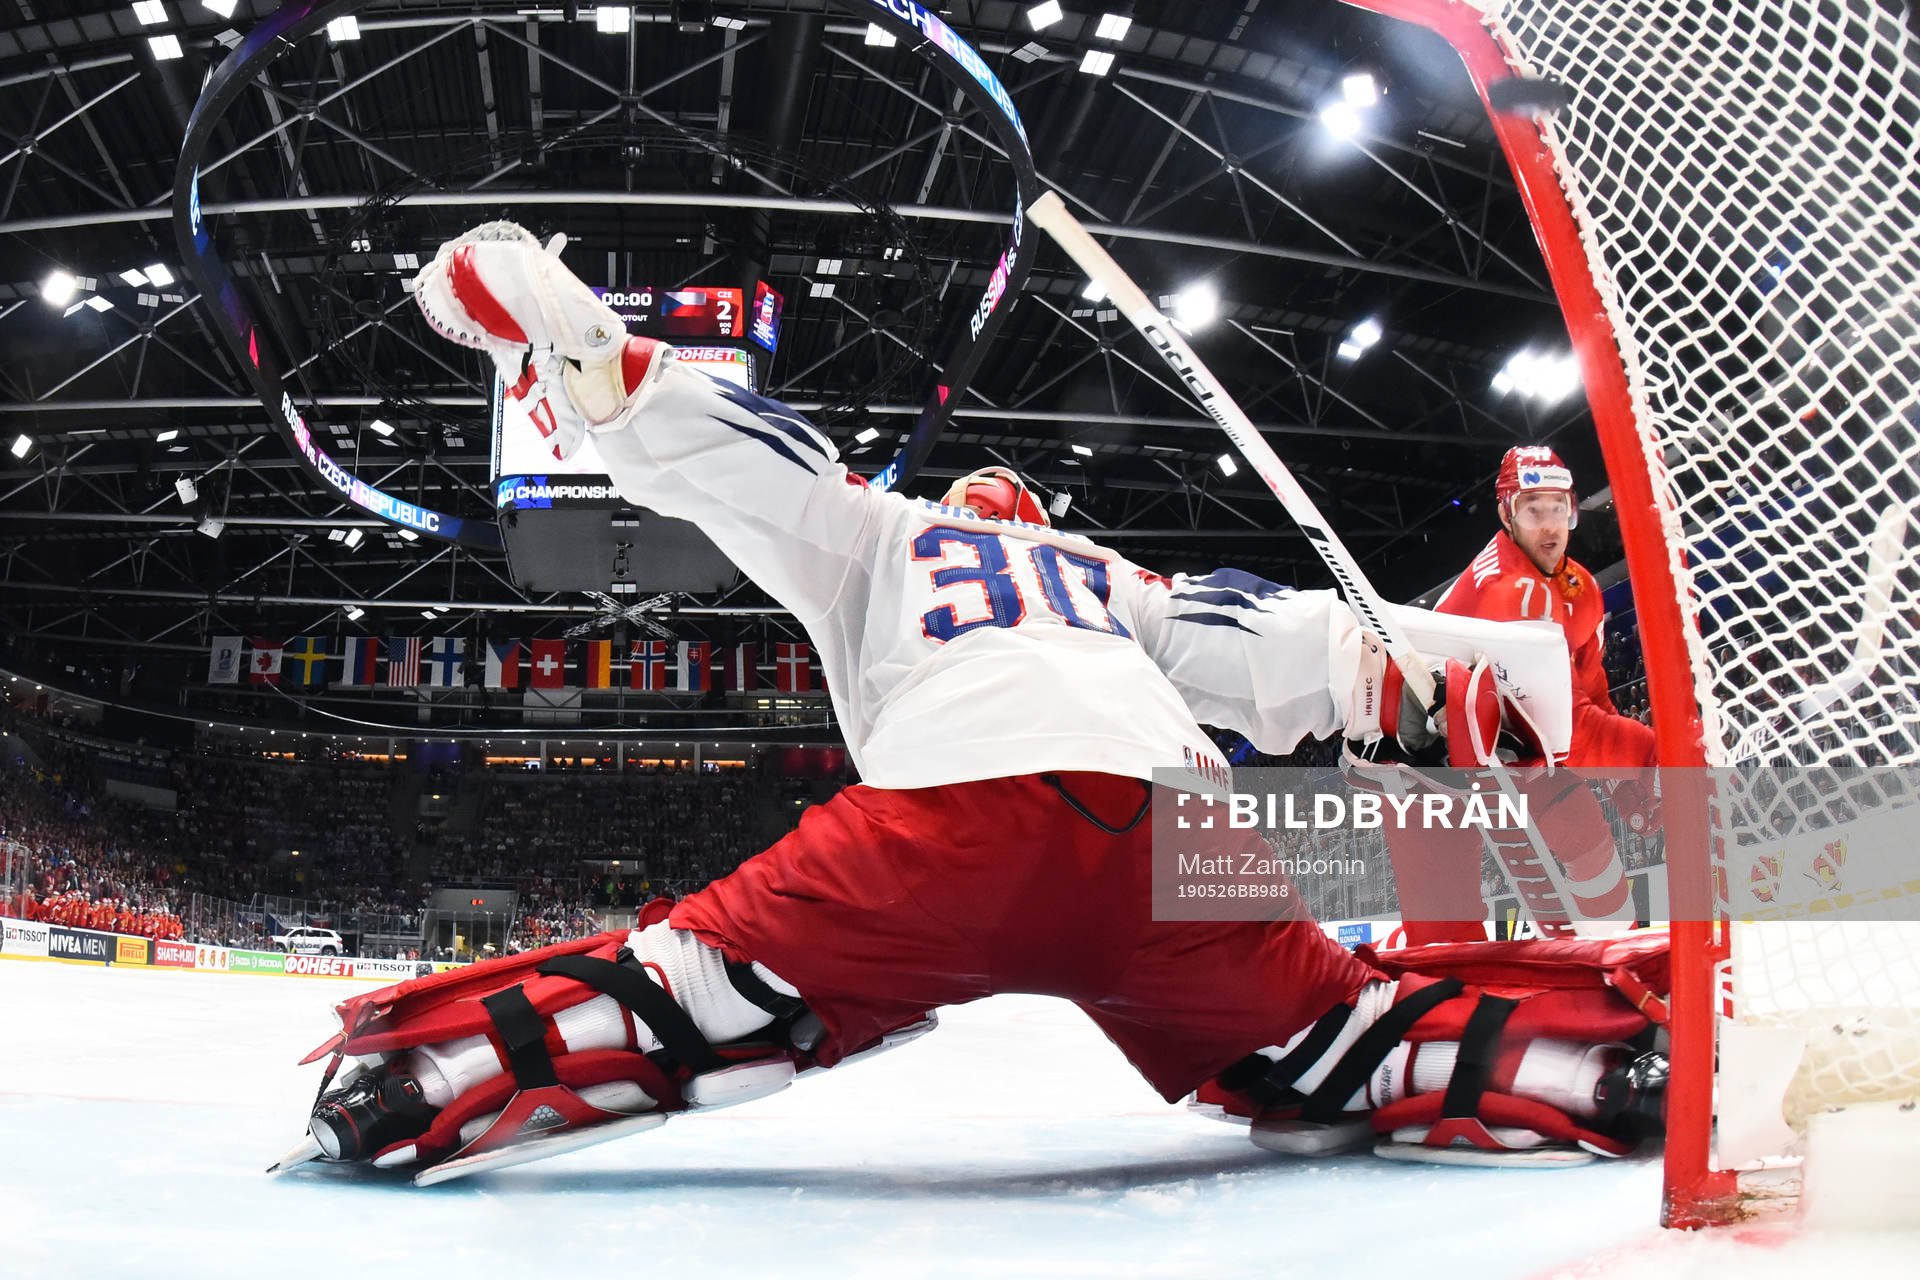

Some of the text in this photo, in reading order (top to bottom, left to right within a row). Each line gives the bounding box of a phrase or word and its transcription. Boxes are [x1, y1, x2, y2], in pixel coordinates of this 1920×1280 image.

[869, 0, 932, 37] CH
[601, 292, 652, 307] 00:00
[716, 300, 732, 320] 2
[970, 270, 1006, 343] RUSSIA
[281, 391, 310, 454] RUSSIA
[317, 453, 357, 496] CZECH
[359, 481, 440, 532] REPUBLIC
[909, 524, 1136, 645] 30
[1514, 577, 1555, 622] 71
[1365, 676, 1373, 716] HRUBEC
[19, 929, 47, 942] TISSOT
[50, 933, 107, 956] NIVEA MEN
[285, 956, 354, 977] ФОНБЕТ
[372, 963, 413, 973] TISSOT
